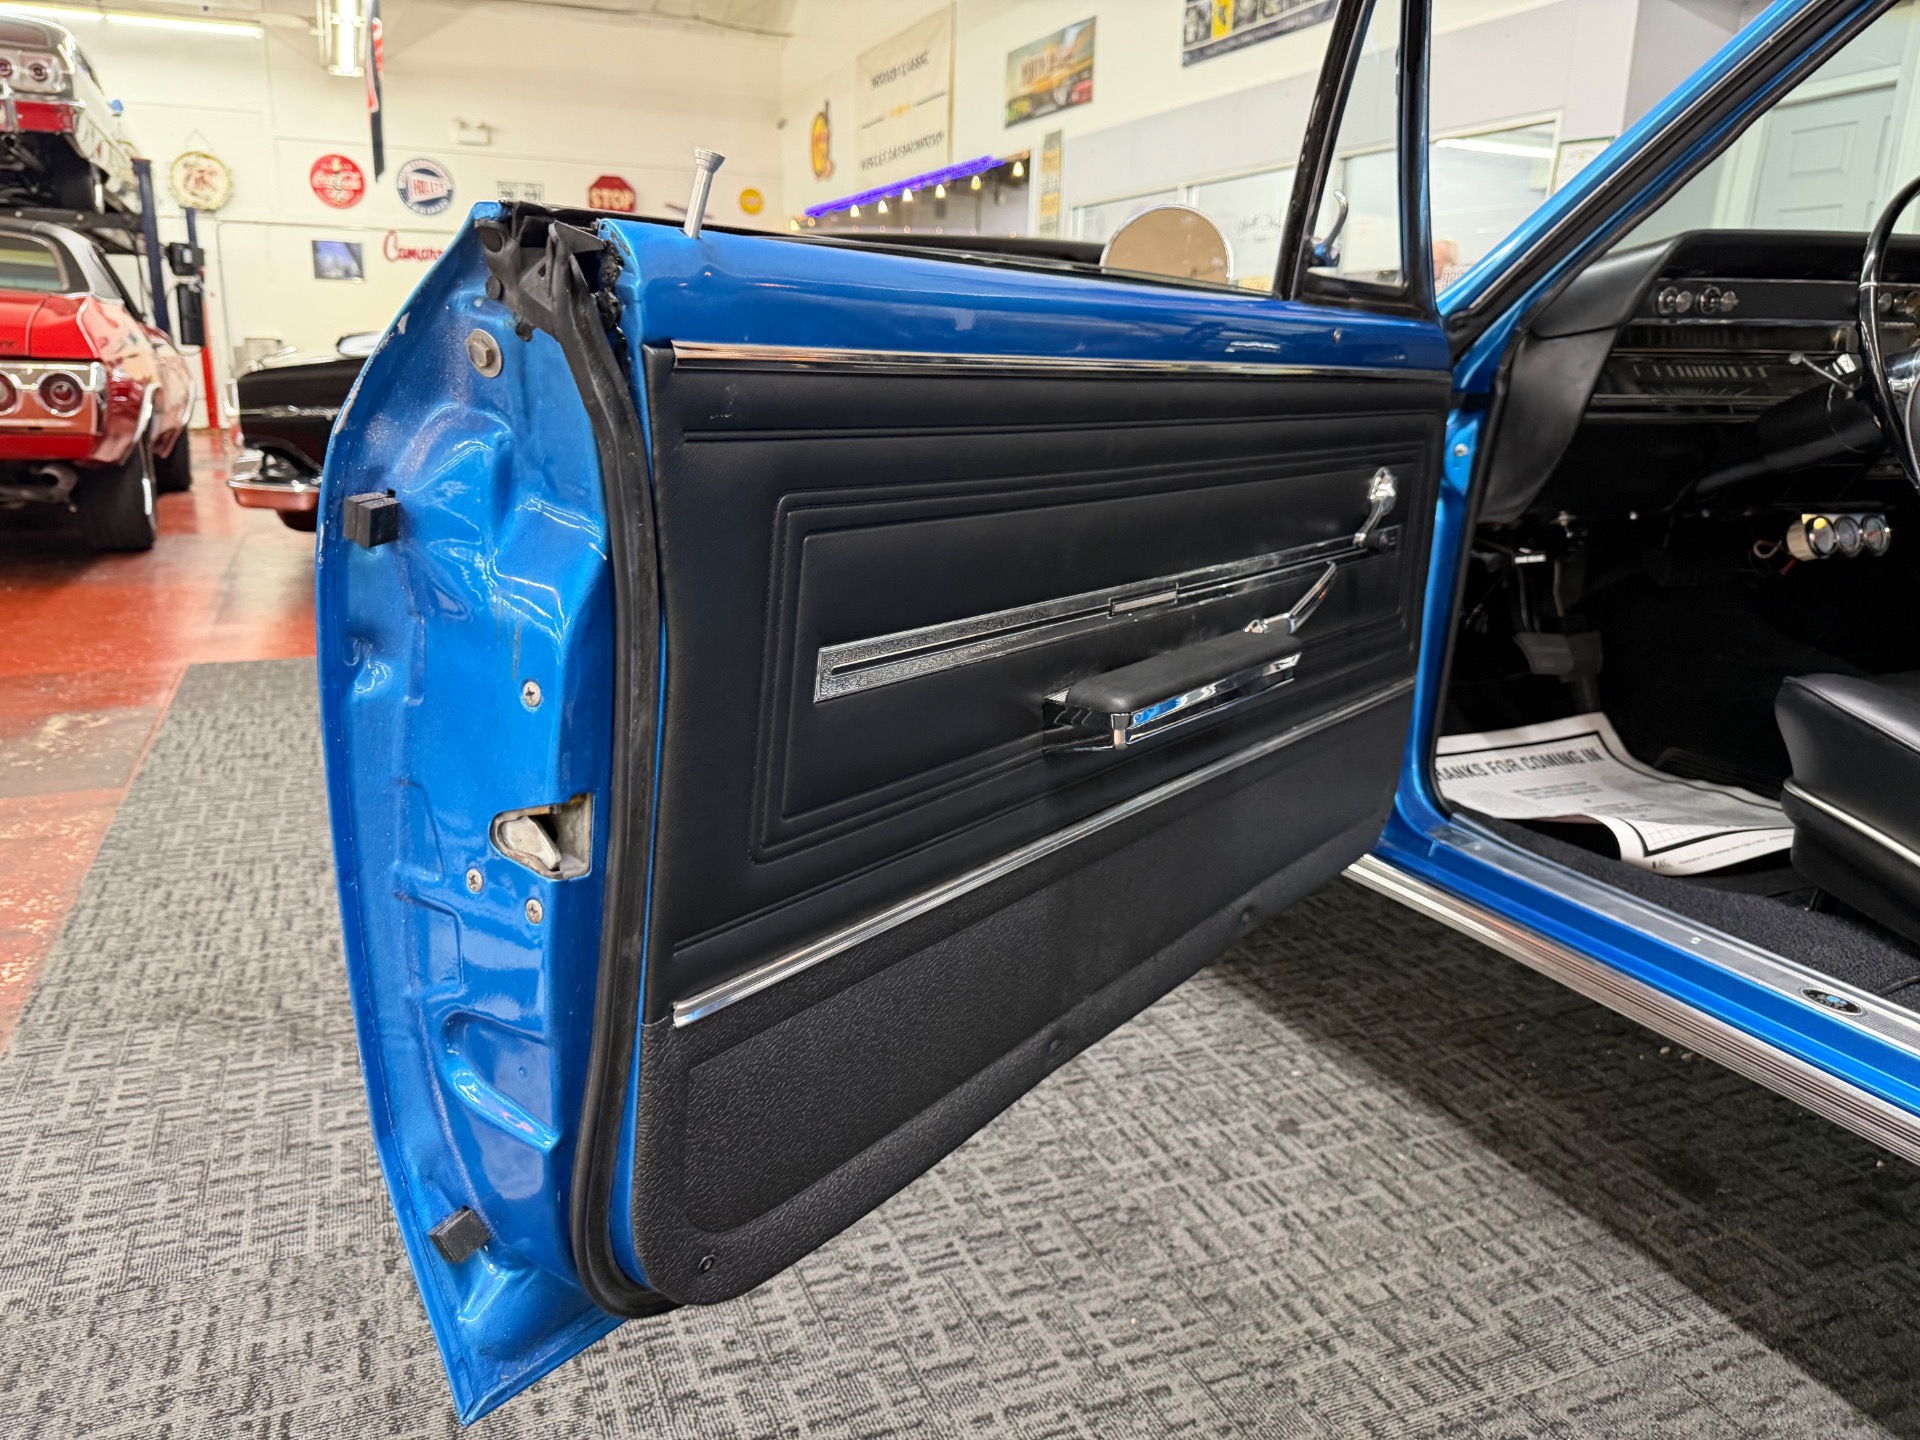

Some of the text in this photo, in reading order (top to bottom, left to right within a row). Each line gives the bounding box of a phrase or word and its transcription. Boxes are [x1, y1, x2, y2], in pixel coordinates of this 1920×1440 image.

[590, 187, 634, 211] STOP
[1436, 748, 1605, 783] HANKS FOR COMING IN
